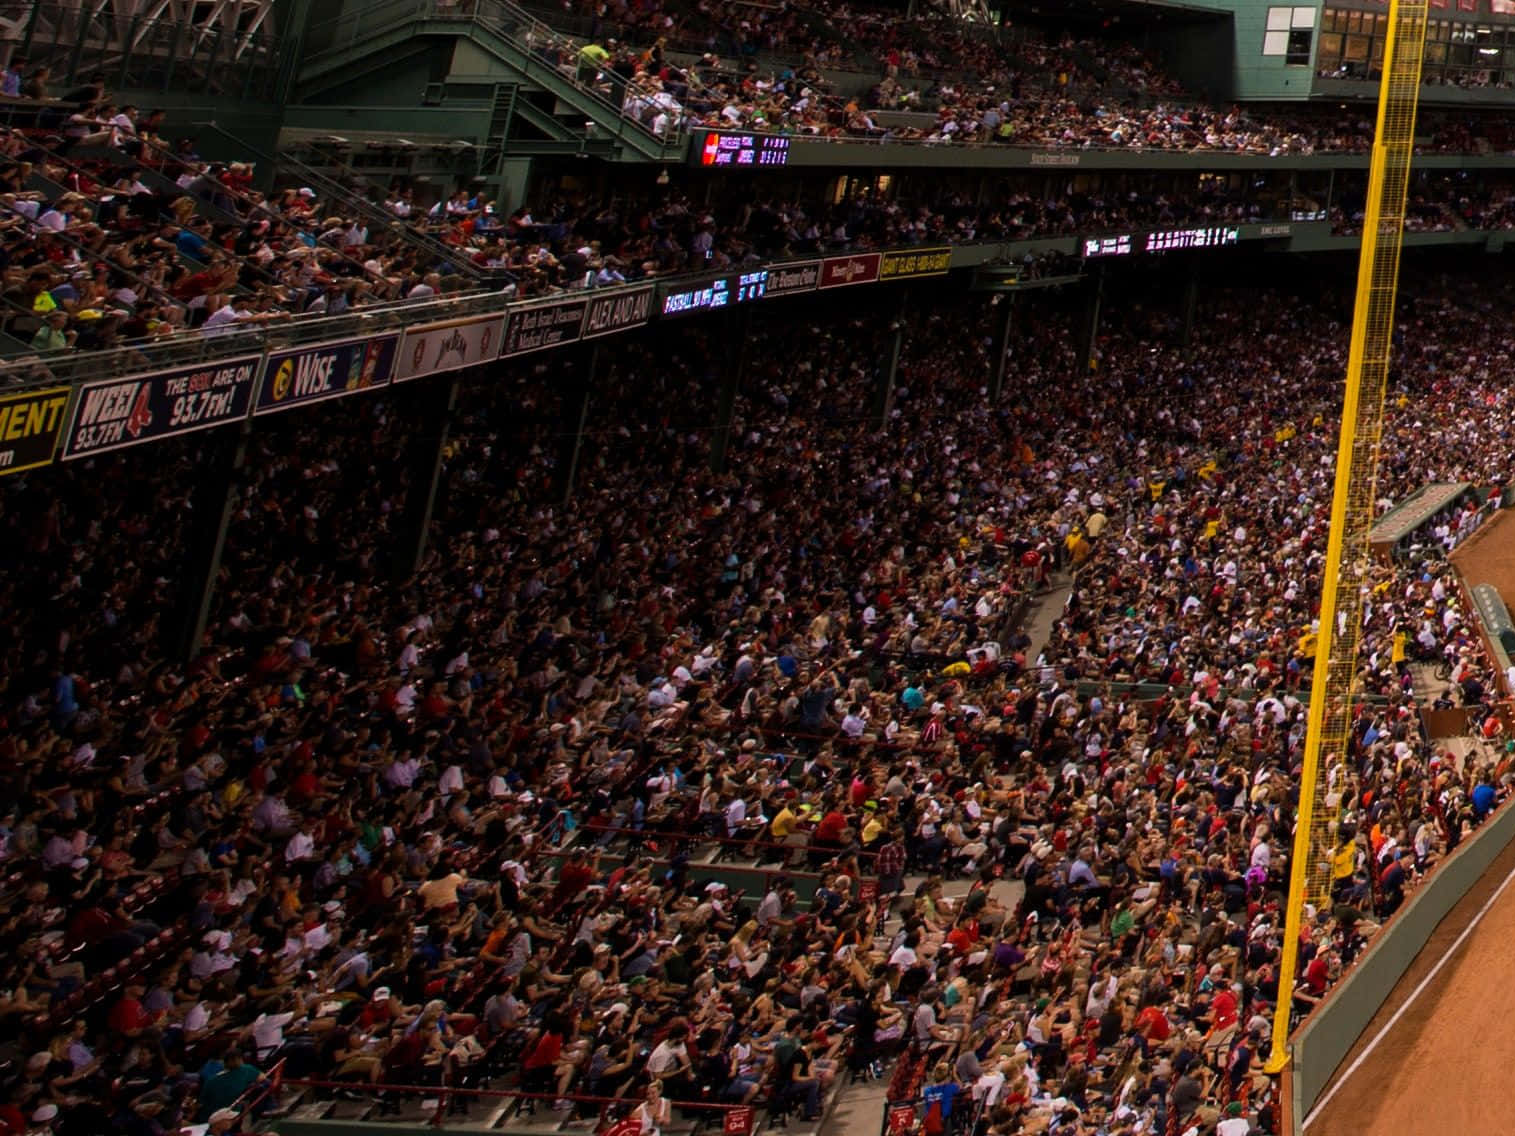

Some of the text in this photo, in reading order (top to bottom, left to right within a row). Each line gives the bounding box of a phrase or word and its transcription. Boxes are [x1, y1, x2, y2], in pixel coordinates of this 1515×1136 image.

[588, 303, 611, 332] ALEX
[166, 376, 189, 396] THE
[212, 369, 233, 388] ARE
[236, 365, 254, 383] ON
[293, 352, 336, 397] WISE
[80, 383, 139, 426] WEEI
[75, 420, 126, 450] 93.7FM
